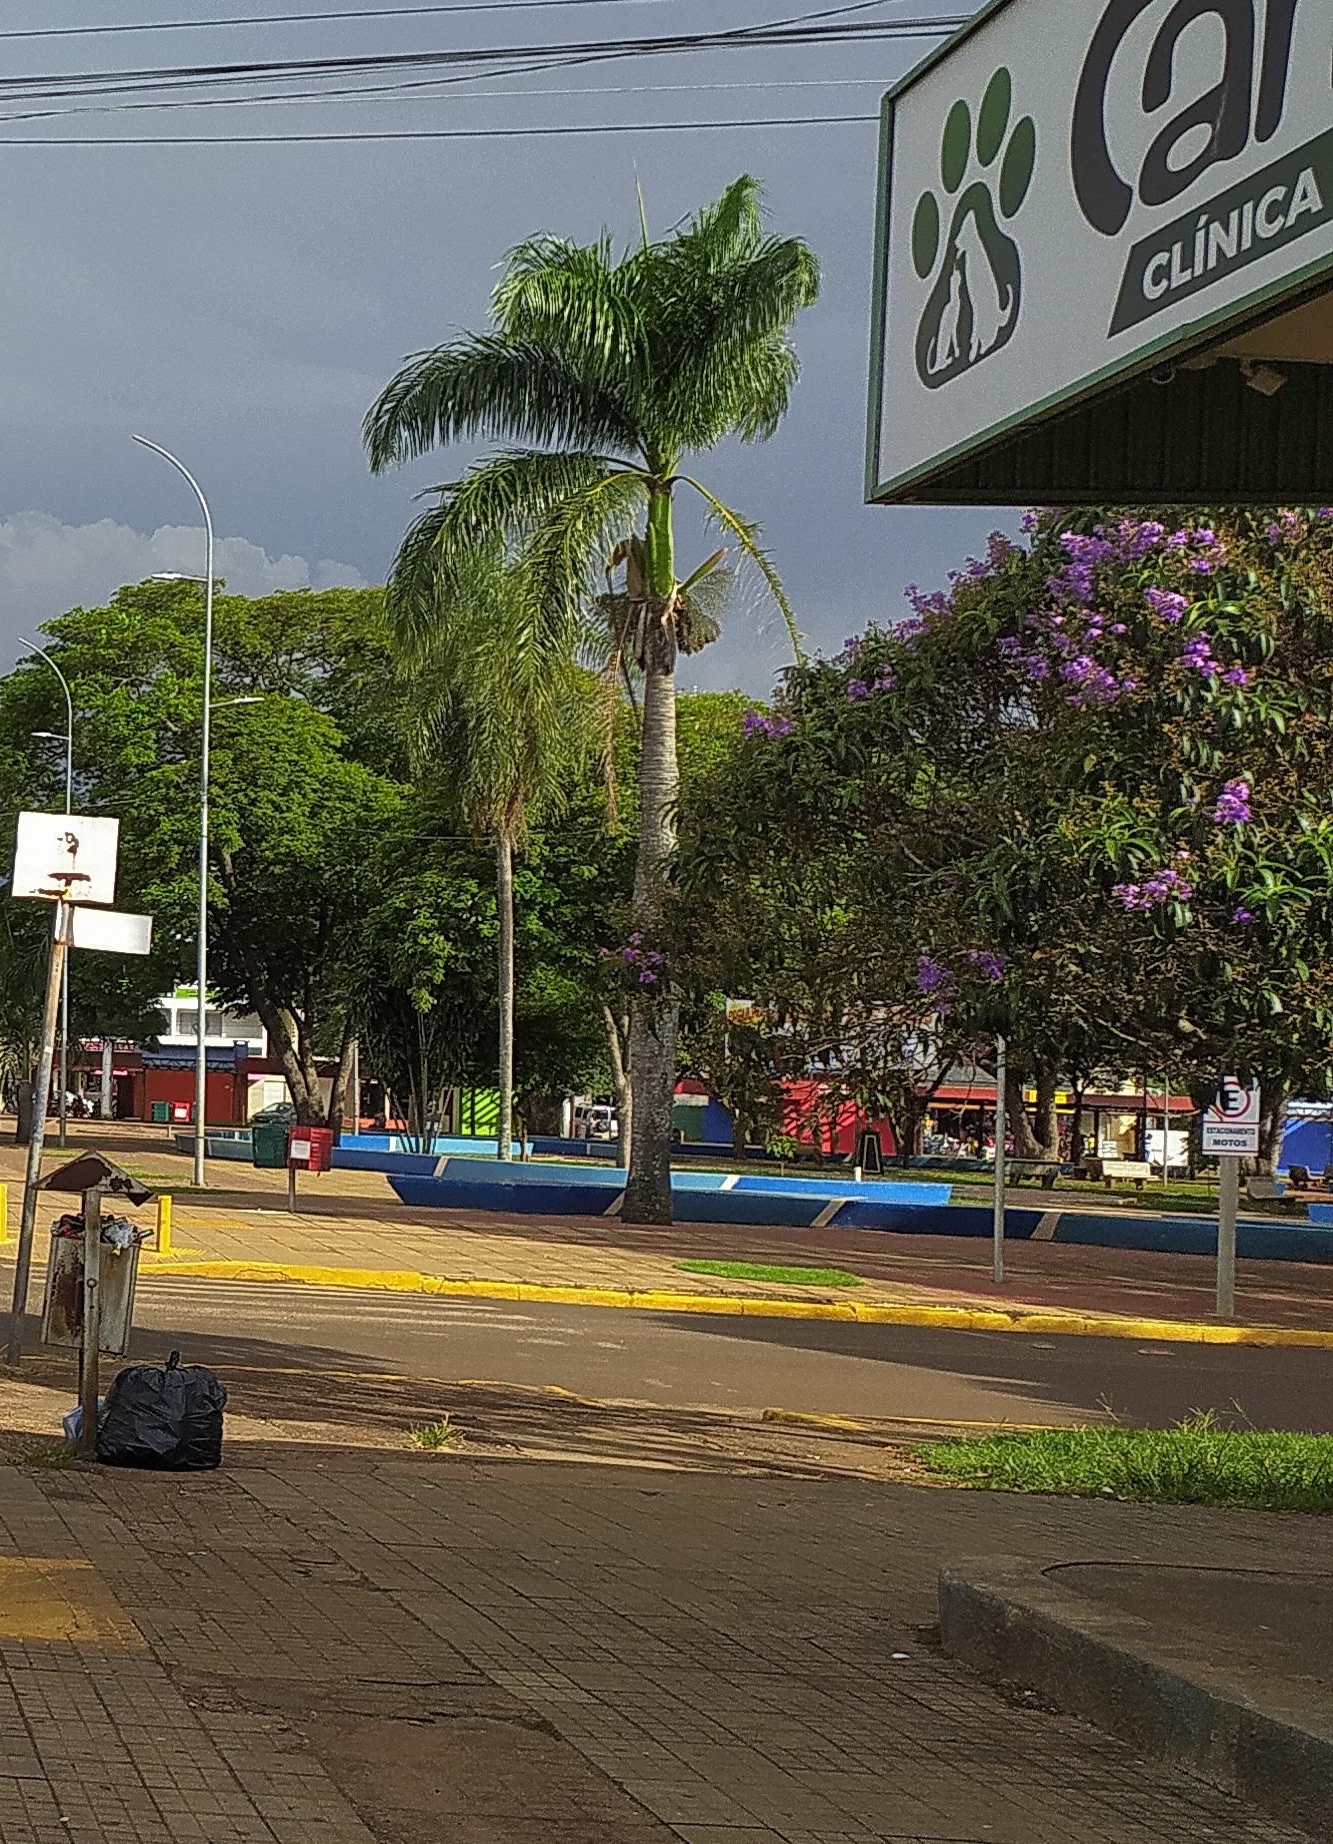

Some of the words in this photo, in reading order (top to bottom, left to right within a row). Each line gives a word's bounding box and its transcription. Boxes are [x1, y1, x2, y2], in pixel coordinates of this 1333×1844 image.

[1143, 166, 1324, 301] CLÍNICA
[1221, 1090, 1239, 1110] E
[1213, 1139, 1248, 1147] MOTOS
